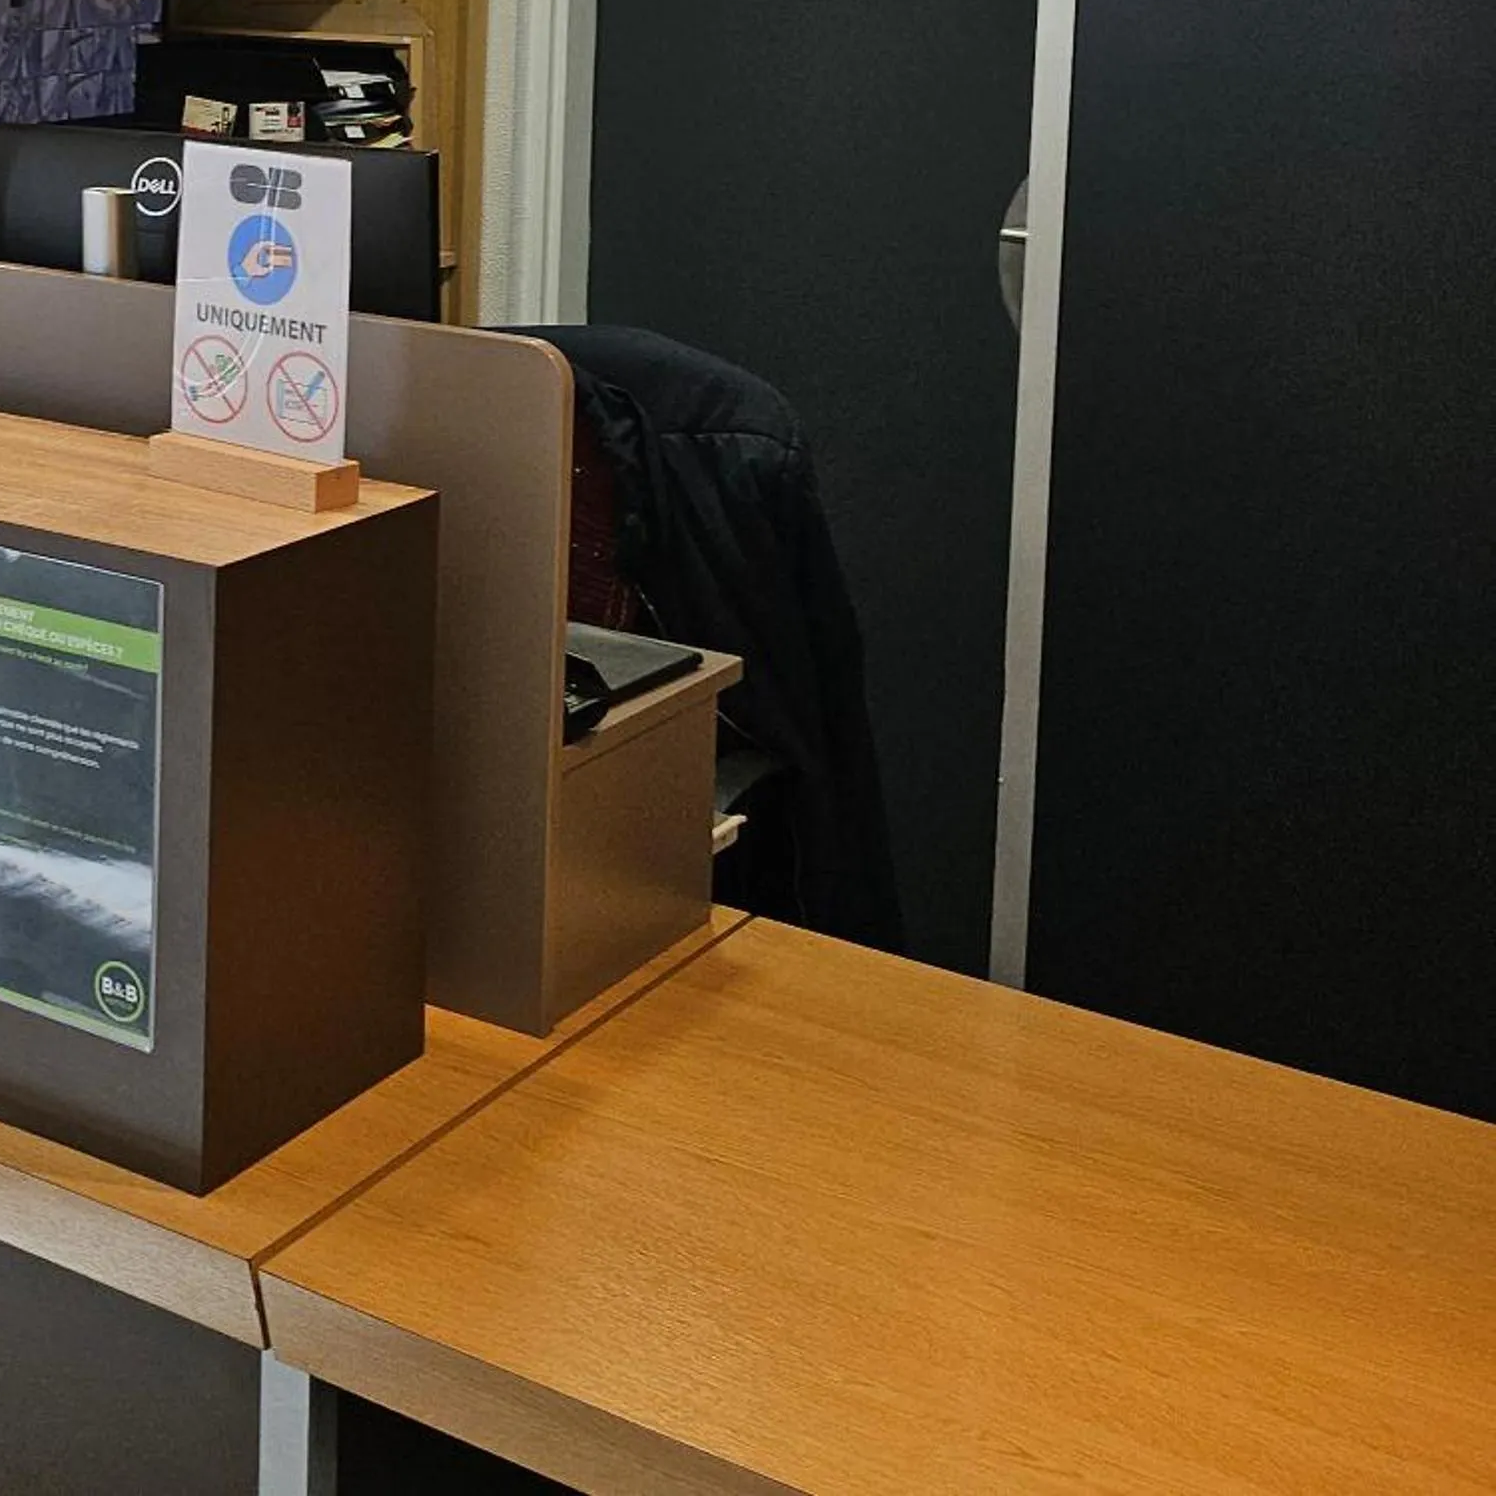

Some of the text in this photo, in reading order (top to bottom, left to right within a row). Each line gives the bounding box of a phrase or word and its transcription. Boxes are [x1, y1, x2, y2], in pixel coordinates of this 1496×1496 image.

[137, 177, 177, 195] DELL
[196, 302, 328, 345] UNIQUEMENT
[101, 976, 138, 1003] B&B
